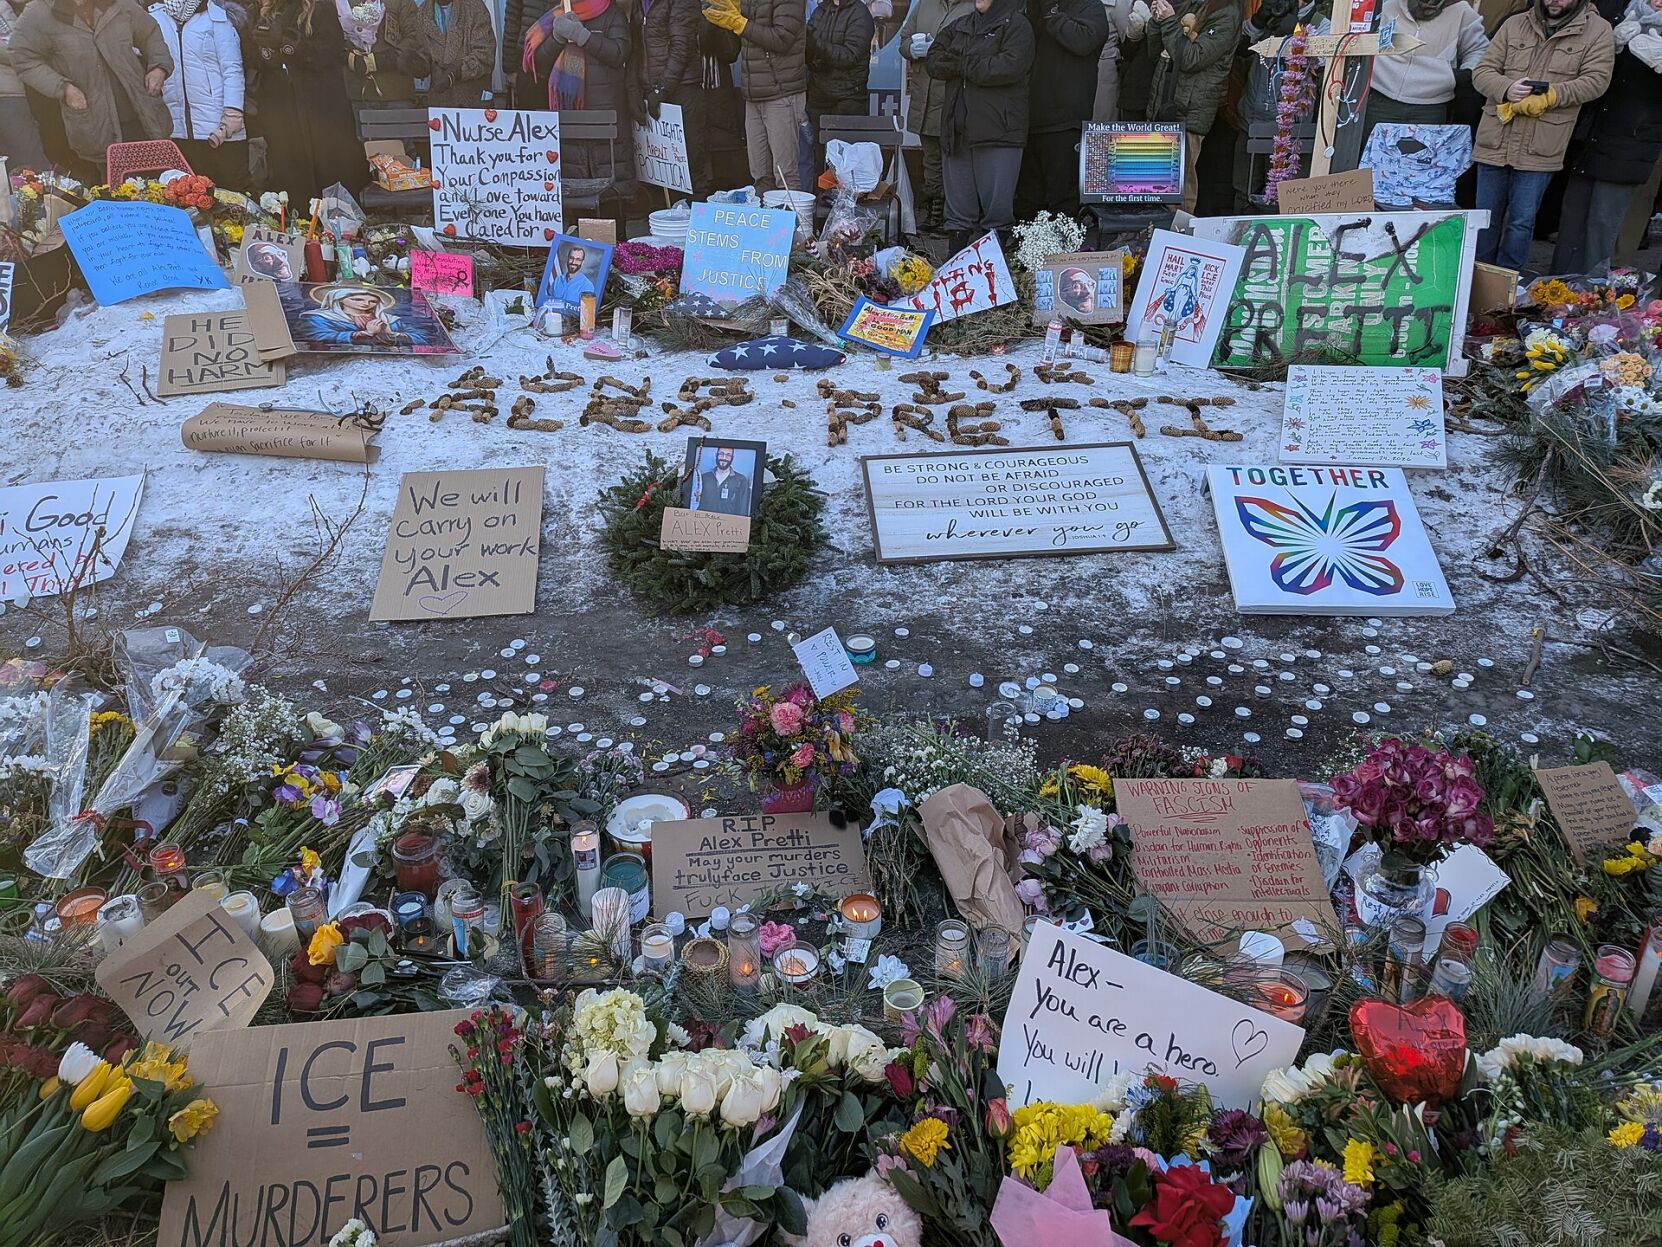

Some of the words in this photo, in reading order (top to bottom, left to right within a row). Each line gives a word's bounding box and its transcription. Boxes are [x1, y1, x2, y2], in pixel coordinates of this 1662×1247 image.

[441, 112, 503, 142] Nurse
[1088, 123, 1110, 132] Make
[1112, 123, 1125, 132] the
[1127, 123, 1152, 132] World
[1154, 123, 1180, 132] Great!
[433, 144, 485, 165] Thank
[488, 150, 515, 169] you
[436, 166, 476, 187] Your
[478, 168, 561, 186] Compassion
[439, 192, 469, 203] and
[474, 191, 513, 203] Love
[517, 189, 561, 203] toward
[439, 205, 509, 225] Everyone
[535, 208, 561, 222] have
[714, 210, 772, 229] PEACE
[252, 230, 297, 246] ALEX
[465, 220, 514, 238] Cared
[687, 229, 740, 249] STEMS
[740, 250, 789, 269] FROM
[1167, 254, 1185, 265] HAIL
[1240, 217, 1430, 290] ALEX
[1164, 263, 1184, 273] MARY
[1203, 263, 1220, 273] KICK
[697, 271, 768, 291] JUSTICE
[191, 316, 243, 333] HE
[168, 333, 255, 352] DID
[194, 348, 248, 367] NO
[168, 358, 273, 385] HARM
[884, 465, 902, 474] BE
[907, 461, 969, 473] STRONG
[974, 462, 982, 470] &
[984, 455, 1089, 469] COURAGEOUS
[916, 474, 939, 484] DO
[945, 473, 975, 483] NOT
[982, 472, 1000, 481] BE
[1005, 469, 1059, 480] AFRAID
[985, 483, 1007, 493] OR
[1013, 476, 1124, 492] DISCOURAGED
[1226, 467, 1390, 489] TOGETHER
[410, 480, 460, 515] We
[471, 478, 522, 504] will
[895, 500, 926, 509] FOR
[933, 498, 961, 507] THE
[967, 496, 1009, 506] LORD
[1012, 493, 1057, 503] YOUR
[1062, 491, 1097, 501] GOD
[25, 491, 116, 533] Good
[969, 508, 1009, 519] WILL
[1013, 507, 1032, 517] BE
[1037, 504, 1080, 515] WITH
[1083, 502, 1119, 512] YOU
[484, 513, 517, 528] on
[672, 520, 712, 537] ALEX
[716, 522, 743, 536] Pretti
[926, 518, 1039, 542] wherever
[1052, 523, 1104, 546] you
[1111, 519, 1146, 542] go
[395, 544, 470, 574] your
[481, 536, 538, 557] work
[403, 564, 501, 597] Alex
[1126, 780, 1187, 797] WARNING
[1194, 781, 1230, 796] SIGNS
[1237, 781, 1257, 793] OF
[1153, 796, 1236, 815] FASCISM
[1133, 824, 1171, 840] Powerful
[1291, 820, 1301, 832] of
[699, 832, 743, 851] Alex
[752, 829, 812, 848] Pretti
[1171, 839, 1184, 851] for
[1188, 840, 1217, 852] Human
[688, 857, 721, 871] May
[727, 855, 764, 871] your
[768, 850, 841, 862] murders
[1138, 855, 1190, 867] Militarism
[1214, 863, 1241, 875] Media
[768, 862, 850, 879] Justice
[1278, 907, 1293, 922] to
[119, 971, 204, 1042] NOW
[1088, 1013, 1128, 1038] are
[1134, 1032, 1156, 1056] a
[1065, 1048, 1104, 1084] will
[271, 1036, 407, 1125] ICE
[180, 1160, 474, 1247] MURDERERS
